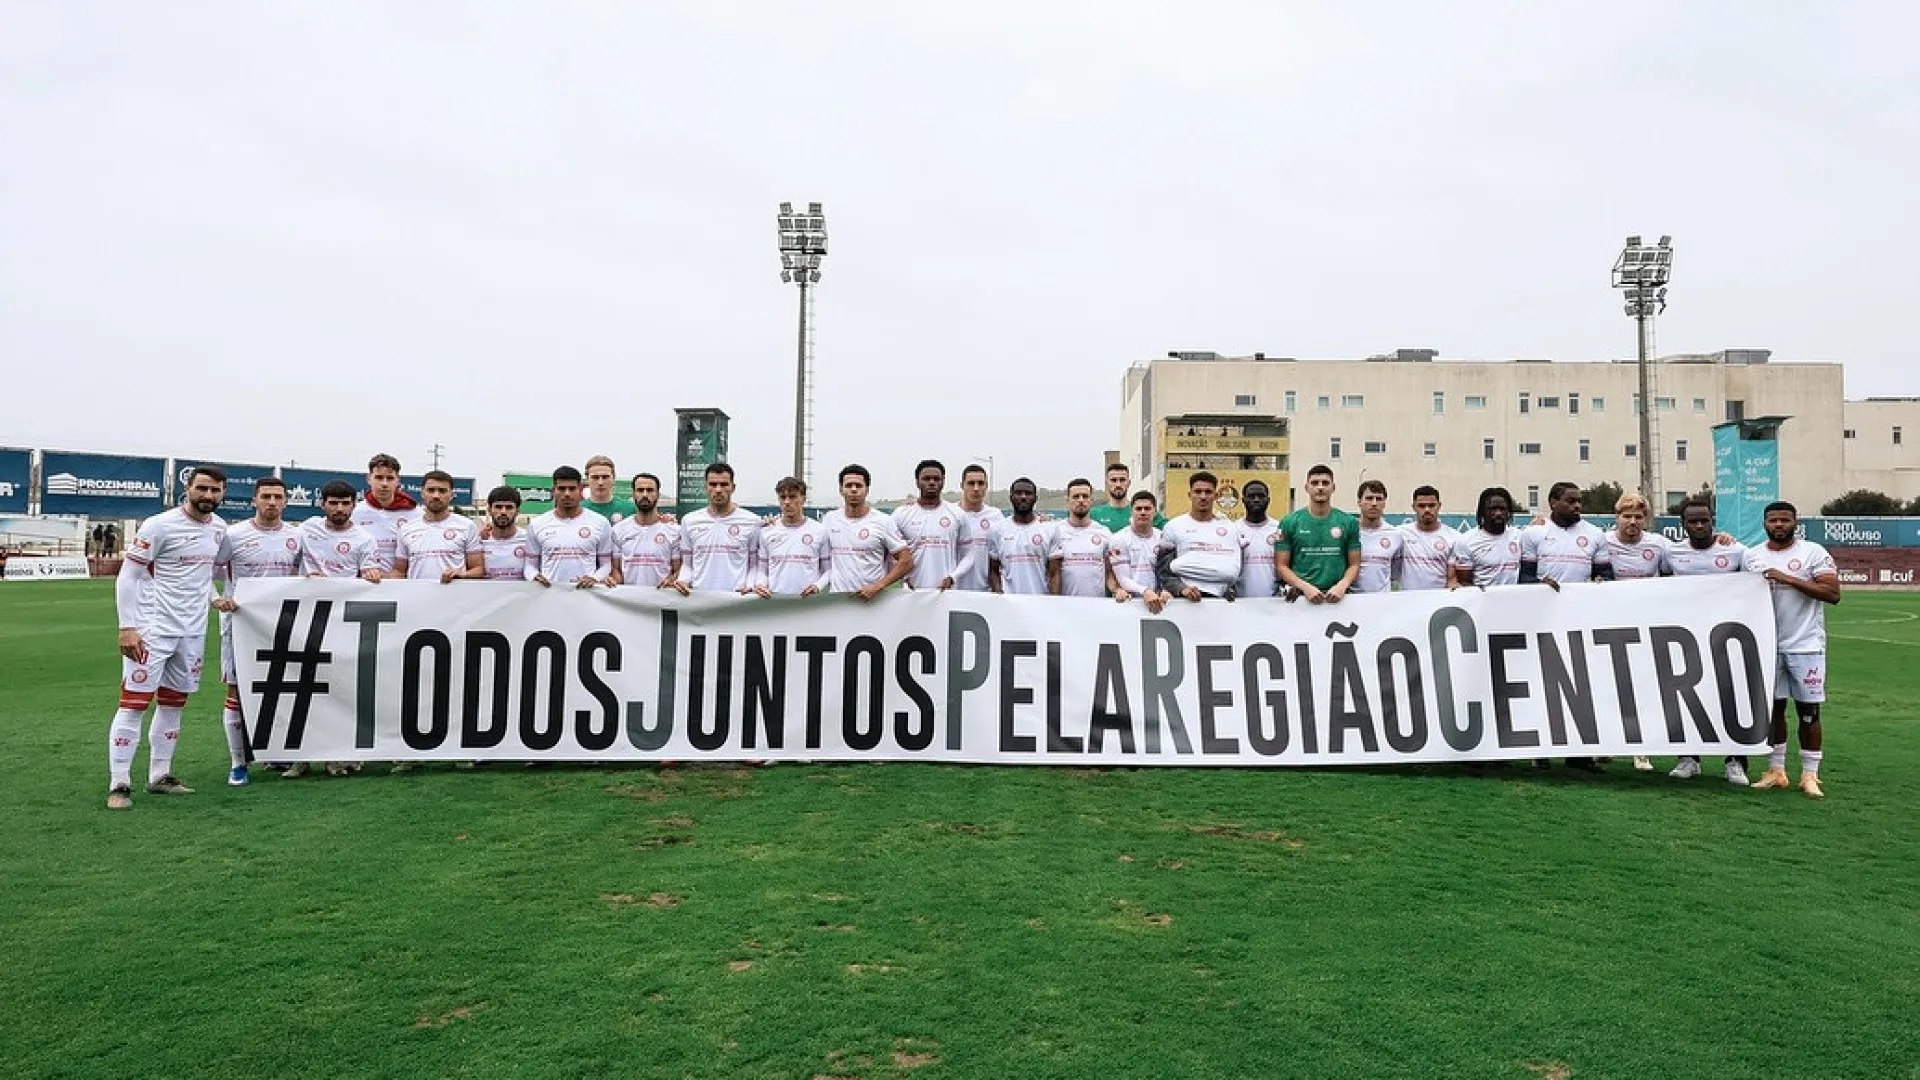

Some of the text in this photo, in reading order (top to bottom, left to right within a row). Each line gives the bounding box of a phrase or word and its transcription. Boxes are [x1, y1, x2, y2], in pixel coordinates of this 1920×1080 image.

[79, 478, 159, 490] PROZIMBRAL
[1824, 520, 1854, 533] bom
[1824, 530, 1881, 543] repouso
[1891, 569, 1914, 583] cuf
